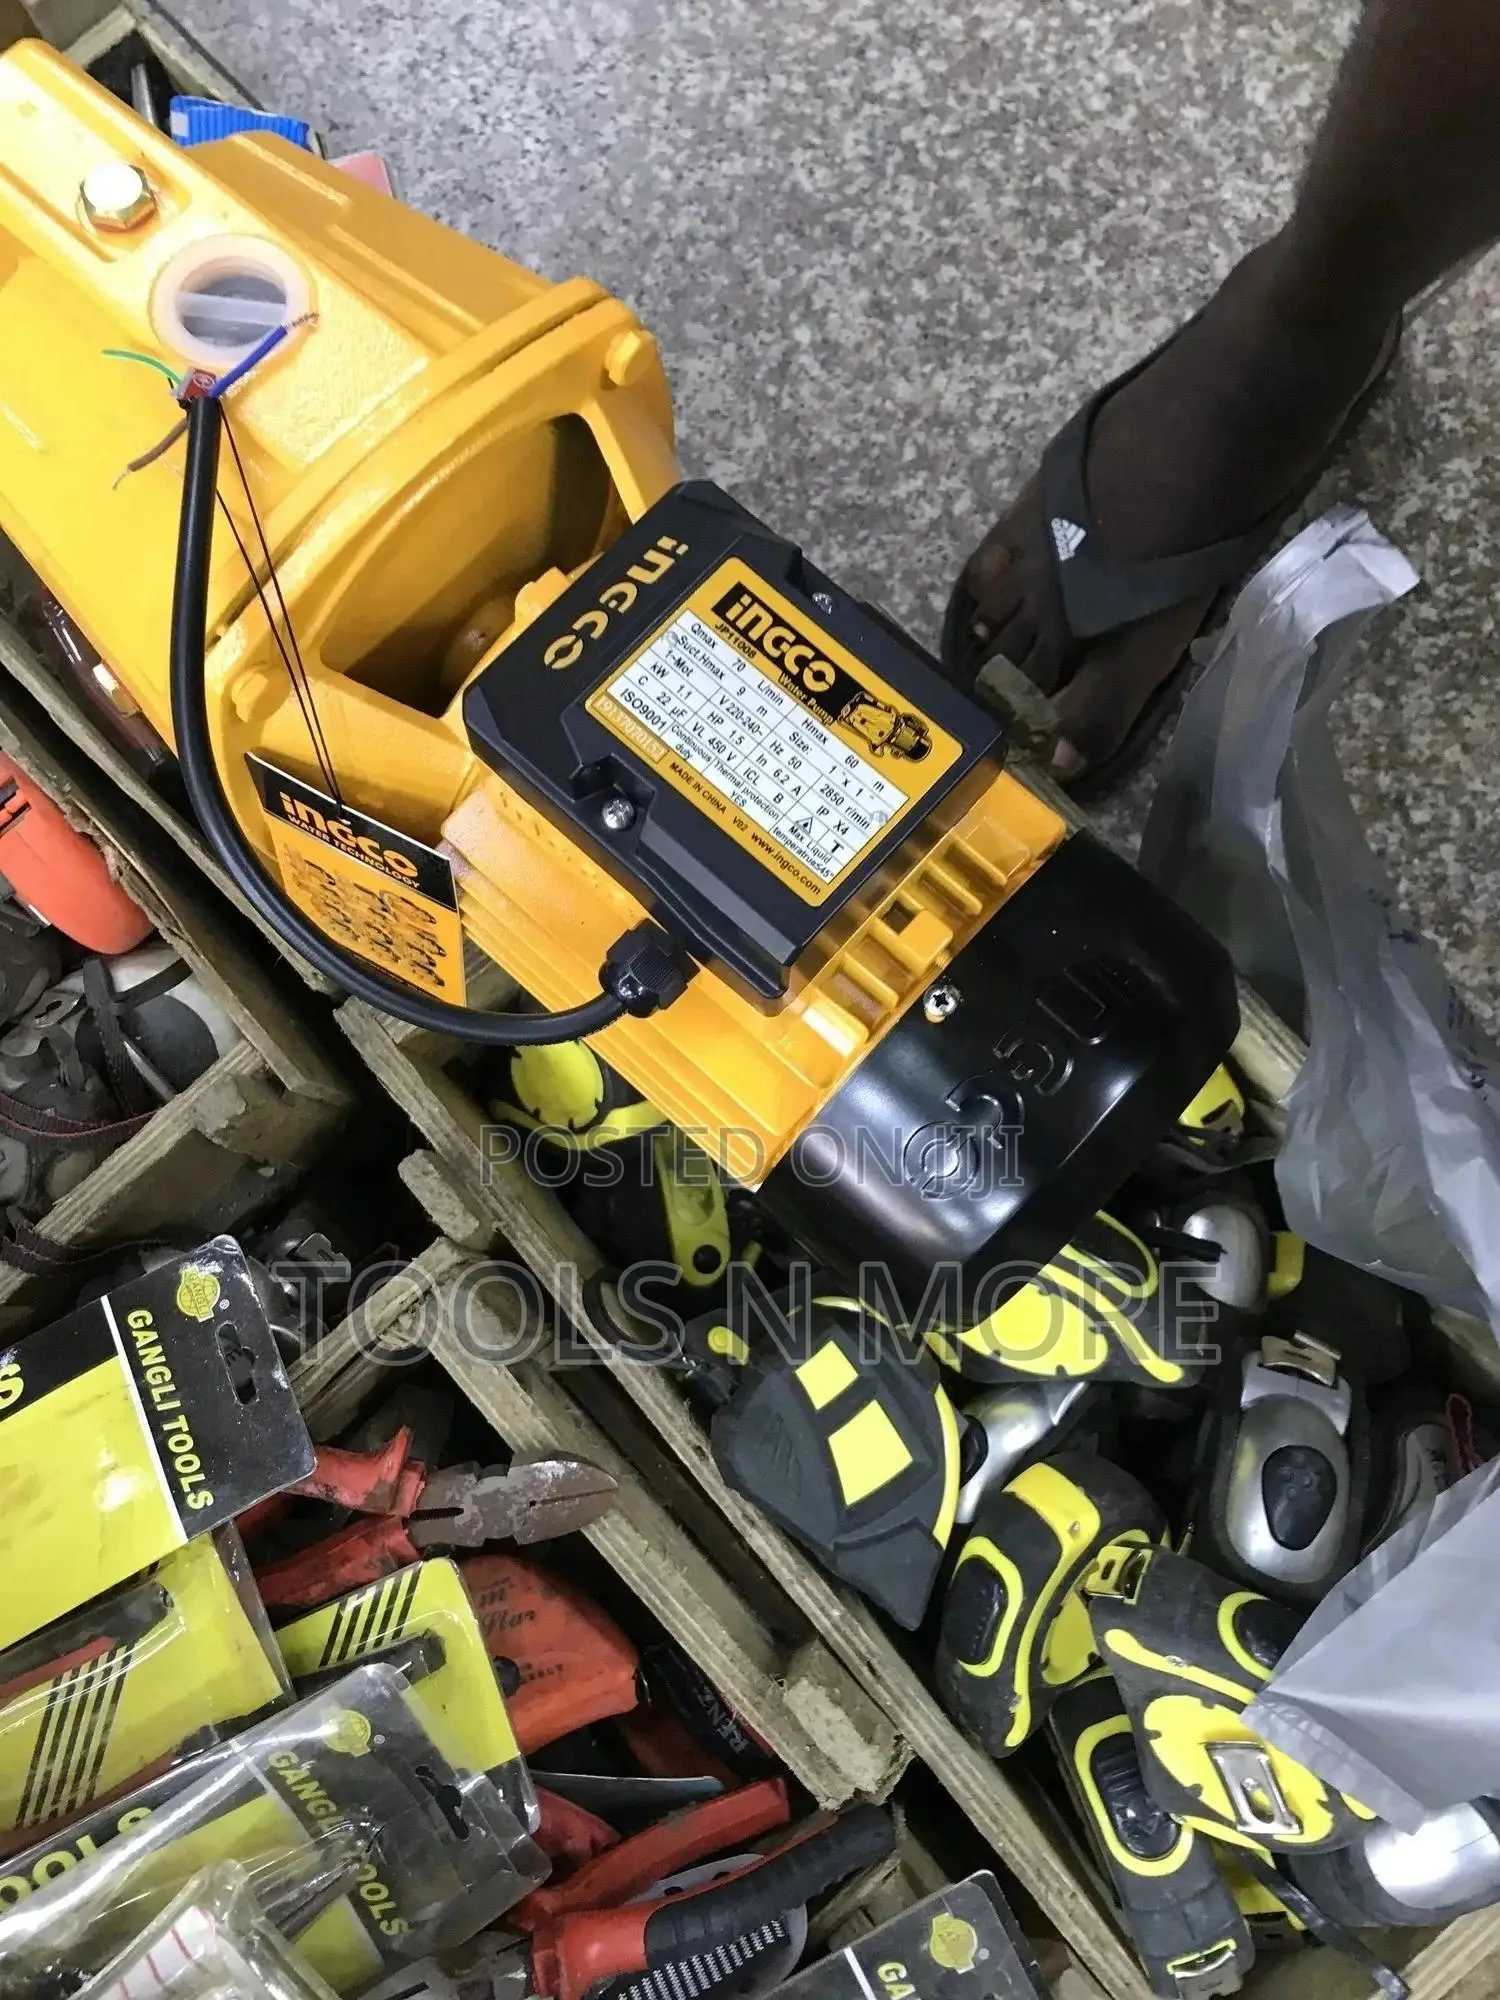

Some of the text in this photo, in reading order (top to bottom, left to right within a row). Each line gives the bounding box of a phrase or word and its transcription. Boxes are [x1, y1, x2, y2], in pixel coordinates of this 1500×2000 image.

[713, 621, 757, 659] JP11008
[649, 662, 692, 700] kW 1.1
[689, 622, 785, 706] Qmax 70 L/min
[619, 687, 668, 730] ISO9001
[636, 674, 648, 686] C
[655, 691, 671, 706] 22
[735, 686, 747, 697] 9
[755, 705, 768, 717] m
[776, 674, 835, 725] Water Pump
[669, 723, 714, 762] Continuous
[690, 722, 736, 763] VL 450 V
[706, 711, 745, 746] HP 1.5
[787, 731, 814, 755] Size:
[672, 742, 693, 762] duty
[769, 740, 802, 770] Hz 50
[800, 718, 885, 791] Hmax 60 m
[668, 761, 728, 814] MADE IN CHINA
[712, 760, 781, 822] Thermal protection
[728, 789, 747, 808] YES
[771, 767, 790, 785] 6.2
[790, 783, 803, 796] A
[771, 792, 784, 804] B
[815, 805, 850, 836] IP X4
[819, 783, 872, 830] 2850 r/min
[287, 814, 421, 889] WATER TECHNOLOGY
[748, 831, 822, 897] www.ingco.com
[804, 840, 832, 865] Liquid
[827, 839, 844, 856] T
[127, 1309, 214, 1511] GANGLI TOOLS
